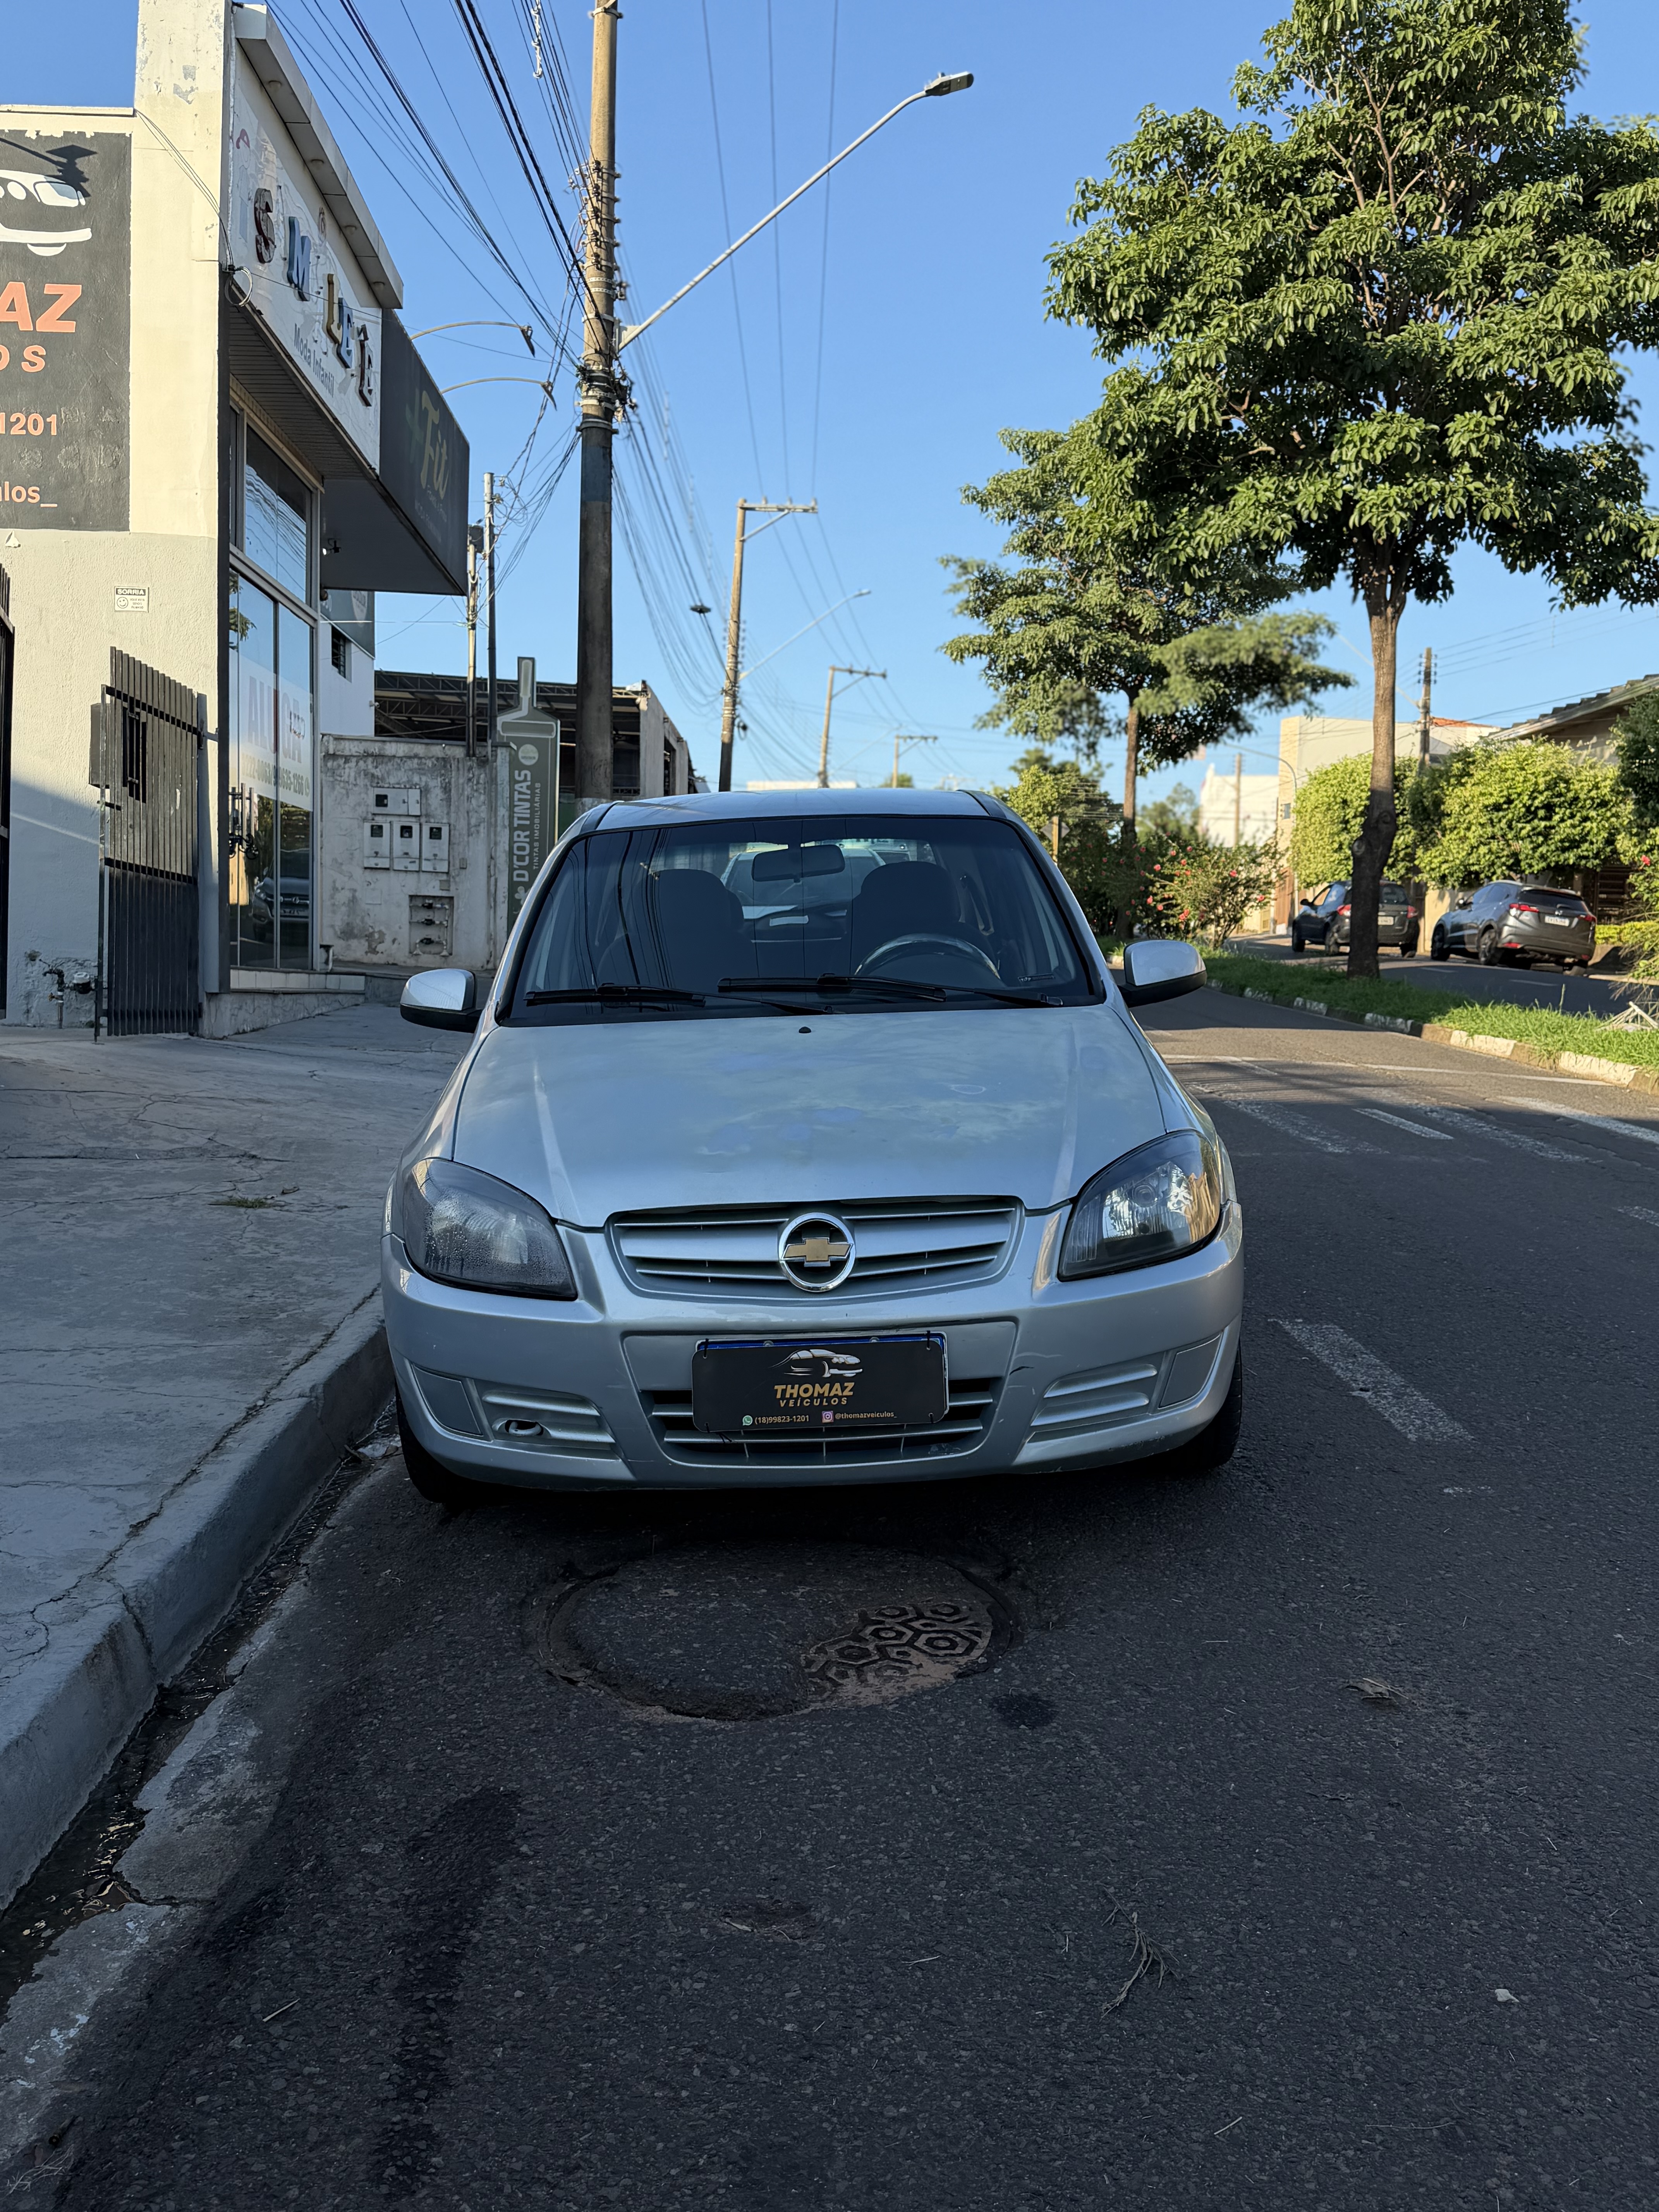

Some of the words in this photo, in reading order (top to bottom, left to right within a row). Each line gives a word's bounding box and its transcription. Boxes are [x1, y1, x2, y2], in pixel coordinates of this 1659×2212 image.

[294, 323, 311, 368] Moda
[313, 350, 334, 398] Infantil
[0, 481, 58, 507] los_
[248, 675, 302, 764] ALUGA
[514, 770, 531, 827] TINTAS
[533, 782, 541, 839] IMOBILIÁRIAS
[513, 830, 530, 882] D'COR
[774, 1382, 855, 1399] THOMAZ
[780, 1397, 847, 1407] VEÍCULOS
[755, 1415, 809, 1424] (18)99823-1201
[835, 1411, 897, 1420] @thomazveiculos_
